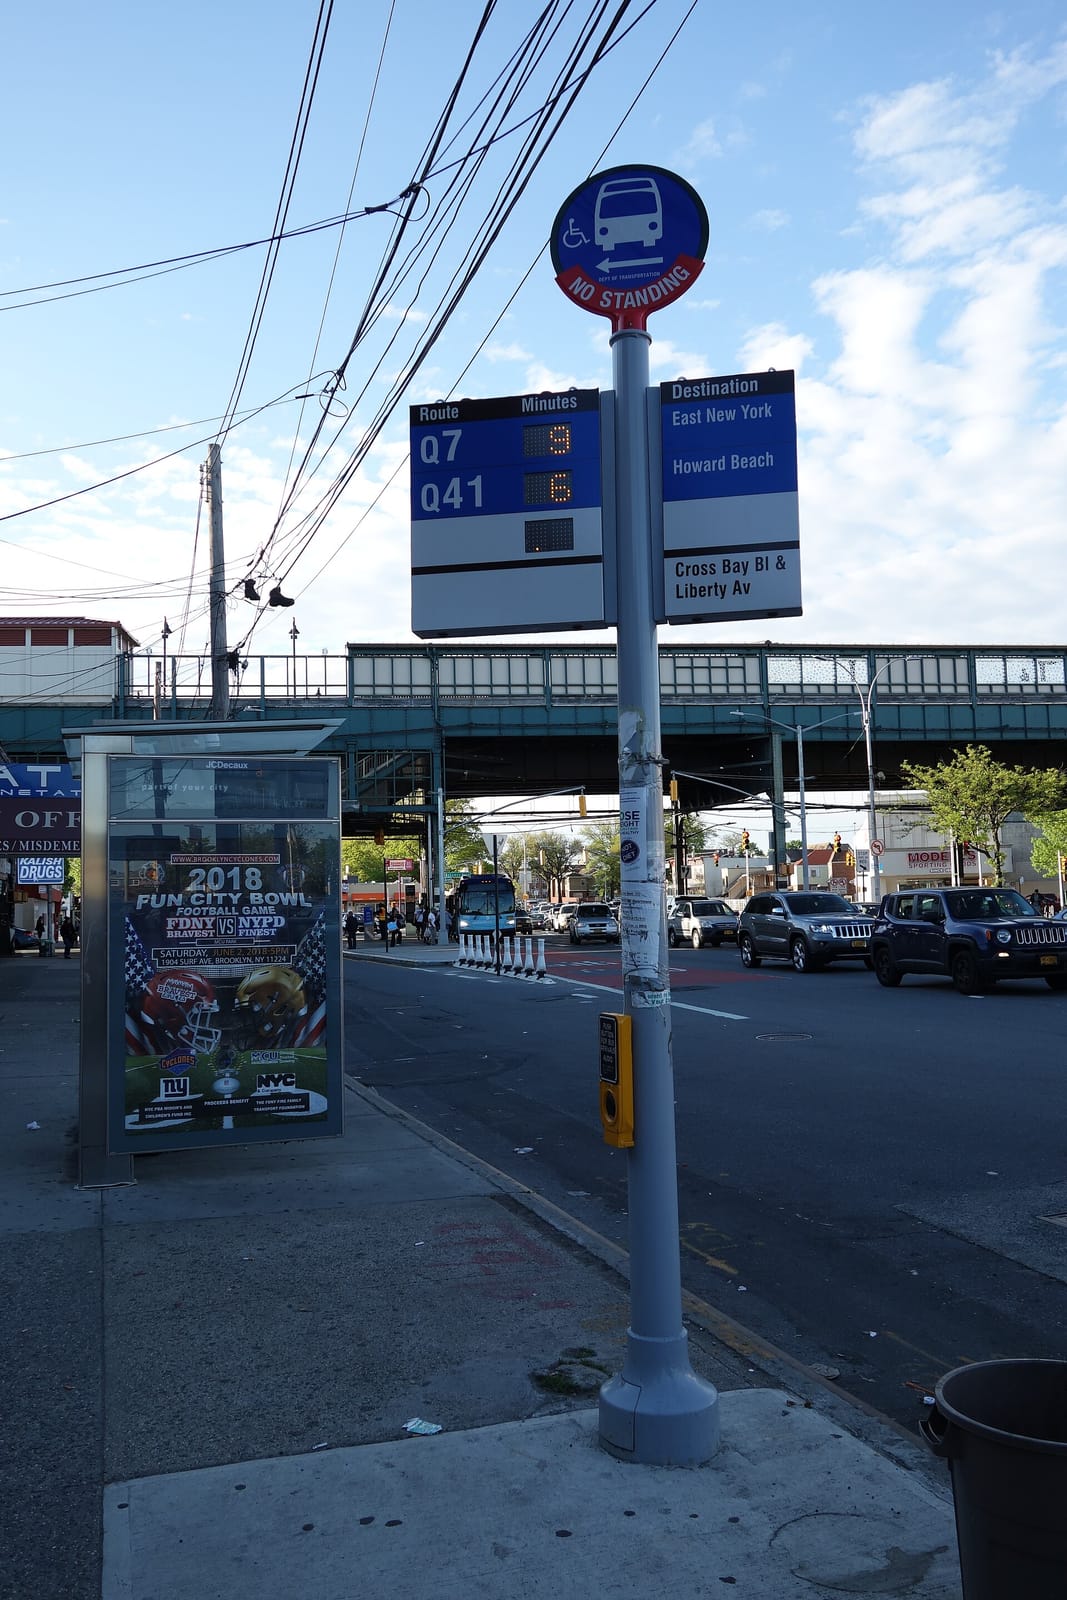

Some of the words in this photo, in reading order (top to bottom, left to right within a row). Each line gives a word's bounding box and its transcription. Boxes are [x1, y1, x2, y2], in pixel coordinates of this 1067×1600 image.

[568, 276, 596, 301] NO
[600, 265, 691, 309] STANDING
[672, 379, 759, 400] Destination
[420, 405, 459, 421] Route
[521, 395, 577, 413] Minutes
[672, 409, 701, 426] East
[706, 407, 735, 424] New
[740, 402, 772, 420] York
[420, 429, 462, 465] Q7
[550, 425, 570, 455] 9
[673, 455, 726, 475] Howard
[731, 451, 774, 470] Beach
[421, 475, 483, 513] Q41
[551, 472, 571, 502] 6
[675, 560, 716, 577] Cross
[722, 558, 749, 577] Bay
[755, 556, 769, 572] Bl
[776, 555, 786, 570] &
[676, 581, 727, 599] Liberty
[732, 580, 751, 595] Av
[205, 760, 249, 769] JCDecaux
[0, 840, 81, 851] S/MISDEME
[20, 865, 62, 878] DRUGS
[189, 866, 263, 890] 2018
[136, 893, 183, 910] FUN
[190, 892, 243, 905] CITY
[250, 892, 313, 908] BOWL
[175, 906, 239, 916] FOOTBALL
[242, 905, 277, 915] GAME
[166, 916, 216, 930] FDNY
[219, 917, 235, 935] VS
[237, 915, 286, 929] NYPD
[166, 929, 216, 938] BRAVEST
[238, 928, 278, 937] FINEST
[160, 948, 209, 958] SATURDAY,
[212, 948, 235, 956] JUNE
[266, 955, 286, 963] 11224
[257, 1073, 295, 1088] NYC
